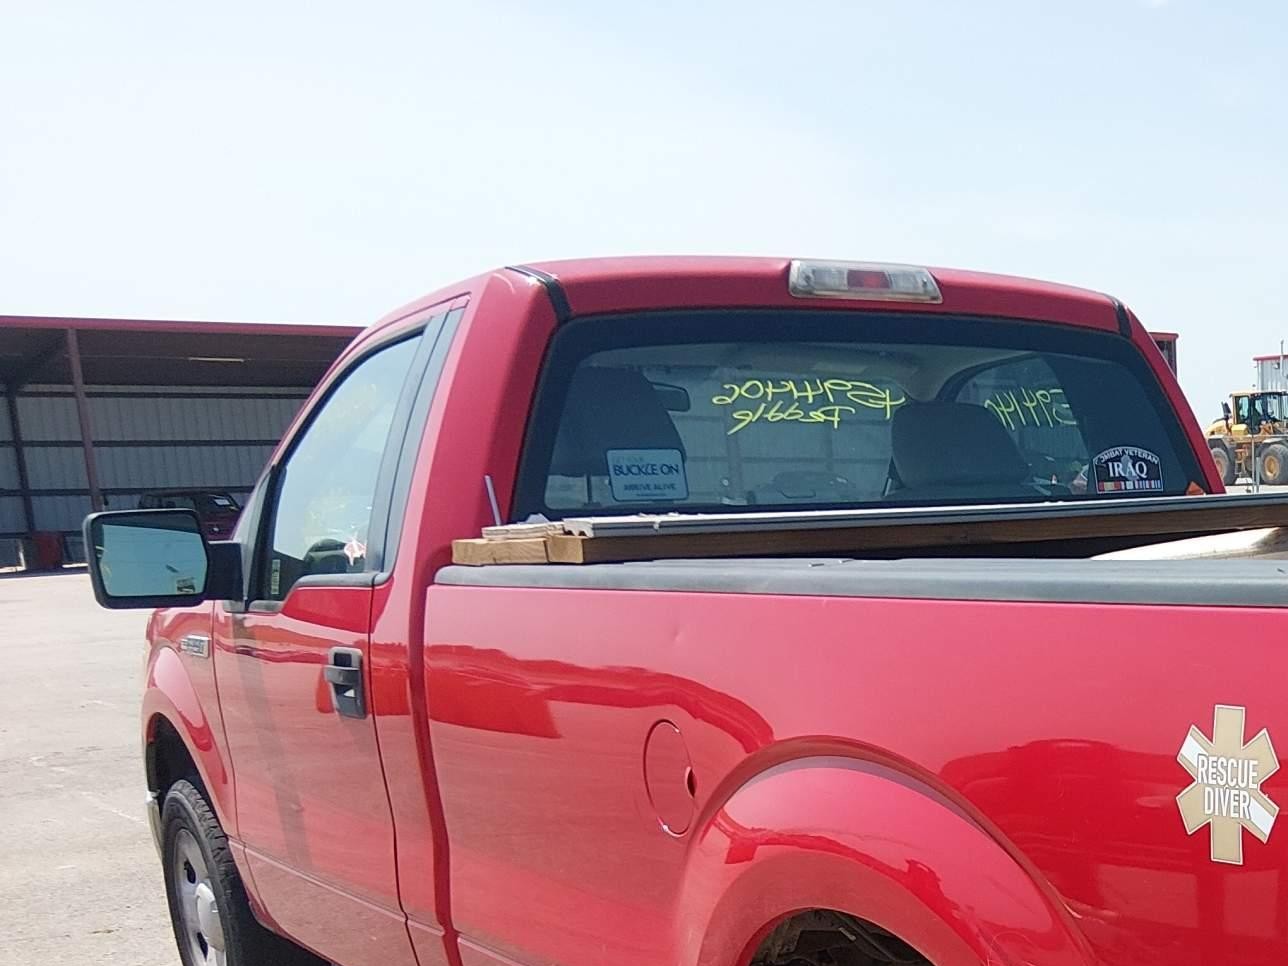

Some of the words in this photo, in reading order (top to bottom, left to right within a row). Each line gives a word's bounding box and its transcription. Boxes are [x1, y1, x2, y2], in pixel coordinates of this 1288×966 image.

[1124, 449, 1159, 464] VETERAN
[613, 464, 660, 476] BUCKLE
[661, 463, 679, 475] ON
[1107, 461, 1148, 479] IRAQ
[1197, 754, 1259, 789] RESCUE
[1203, 784, 1252, 820] DIVER
